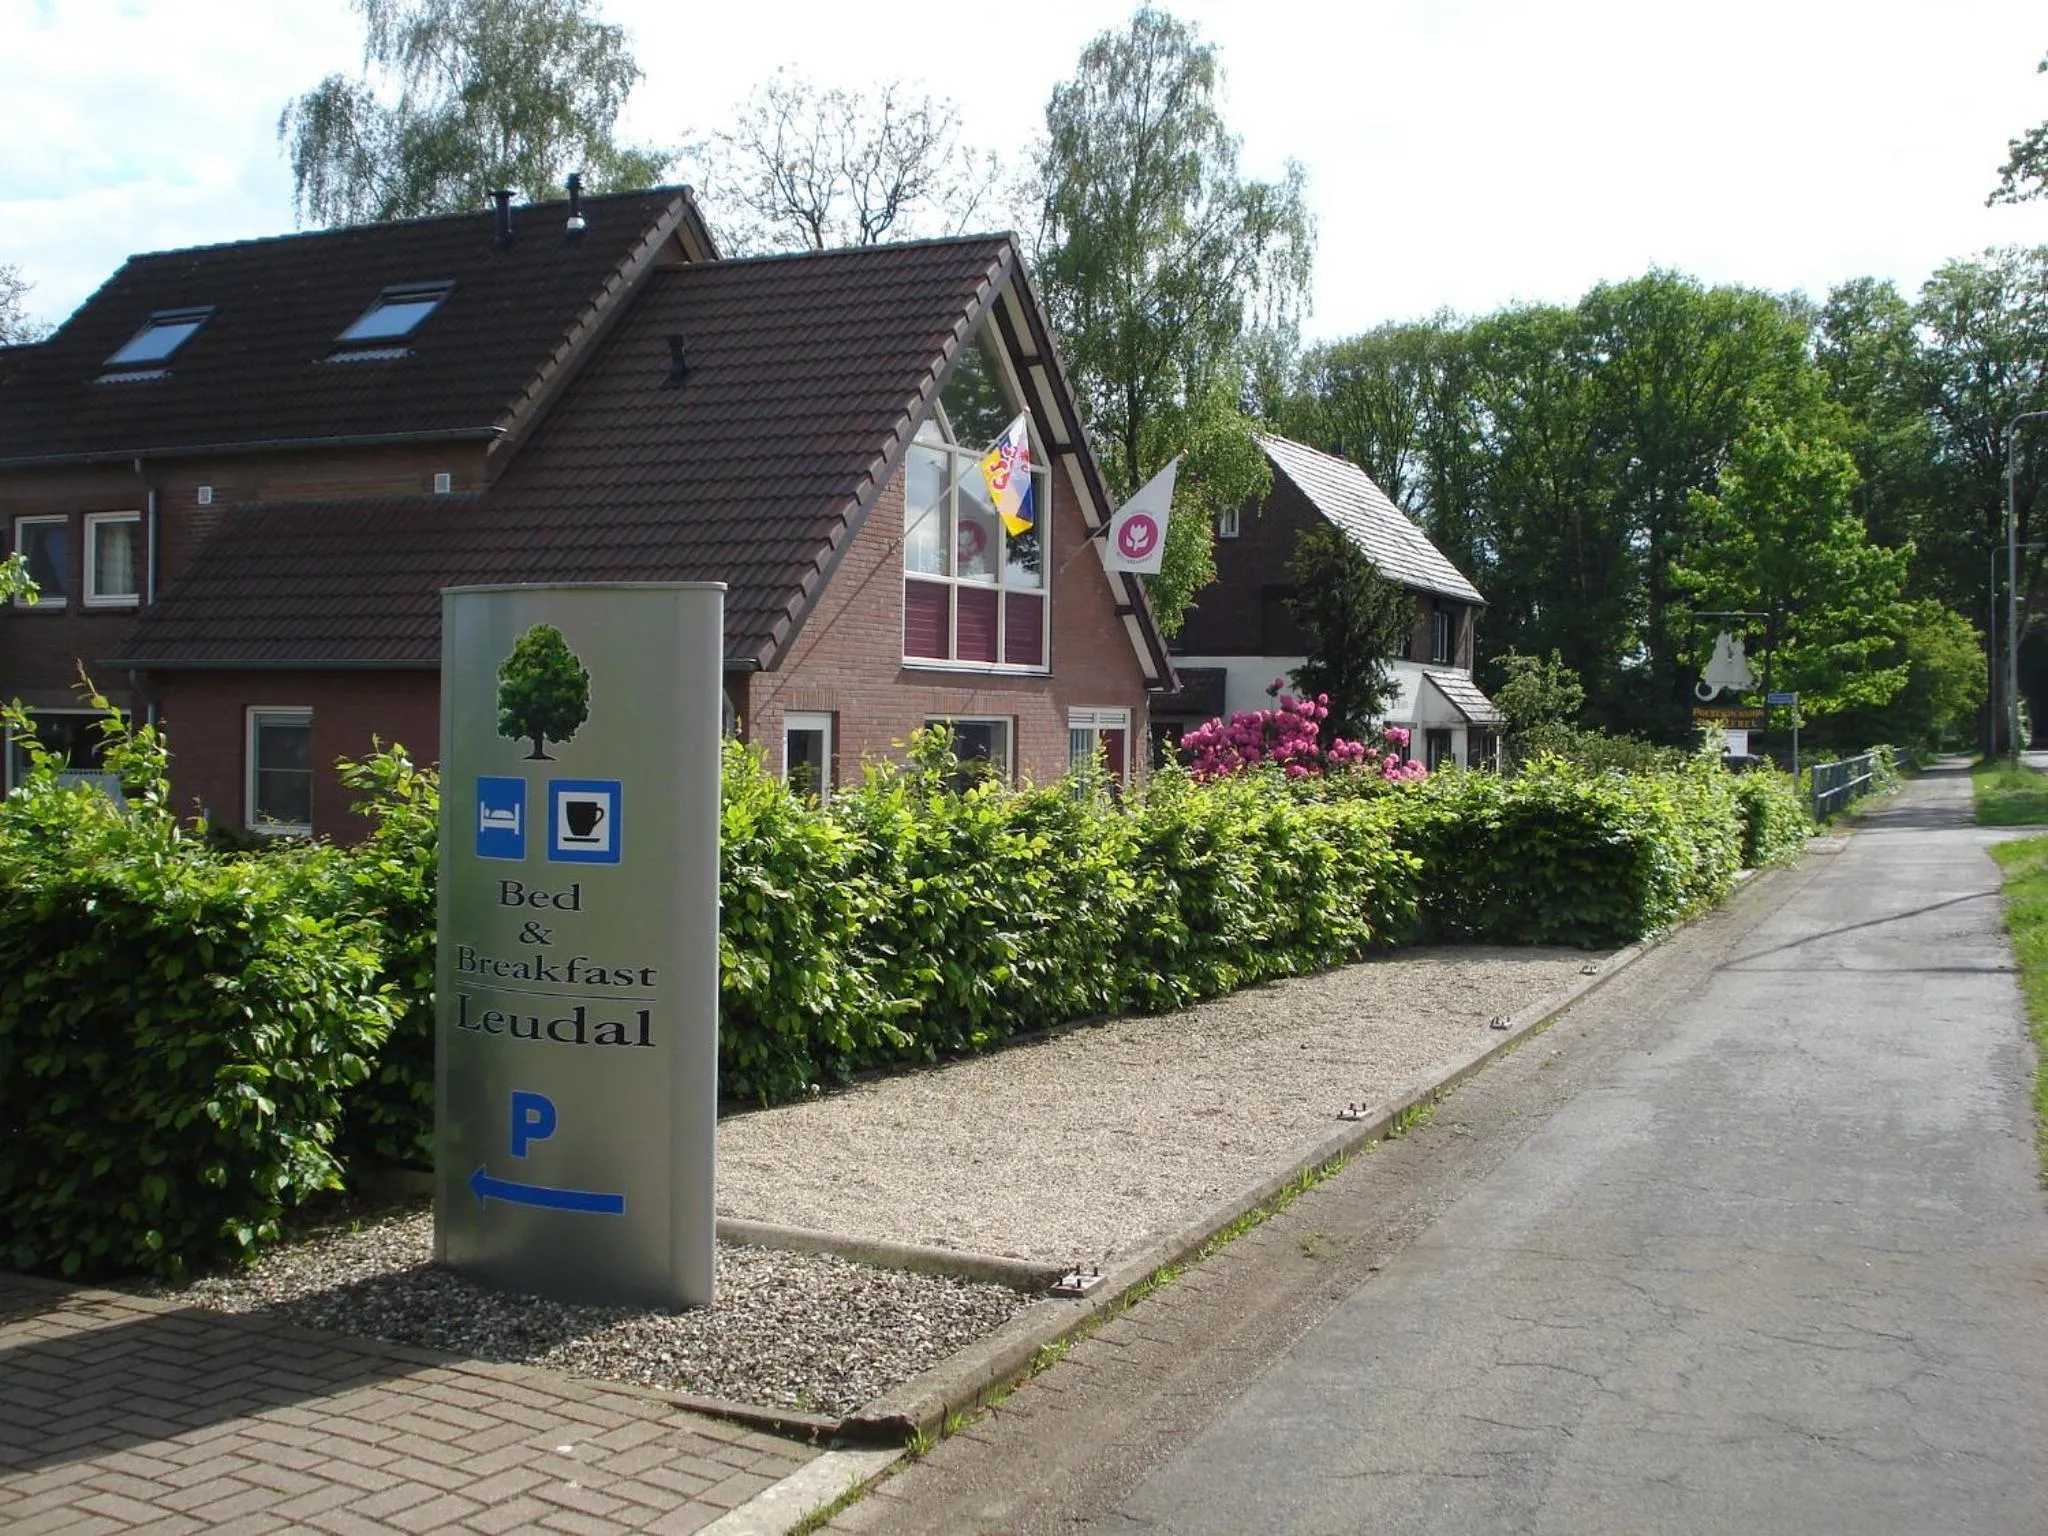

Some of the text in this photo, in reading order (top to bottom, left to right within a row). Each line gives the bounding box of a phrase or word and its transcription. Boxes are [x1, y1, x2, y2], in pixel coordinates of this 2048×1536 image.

[498, 880, 582, 911] Bed
[518, 920, 553, 945] &
[457, 945, 657, 987] Breakfast
[456, 994, 656, 1047] Leudal
[510, 1090, 558, 1159] P
